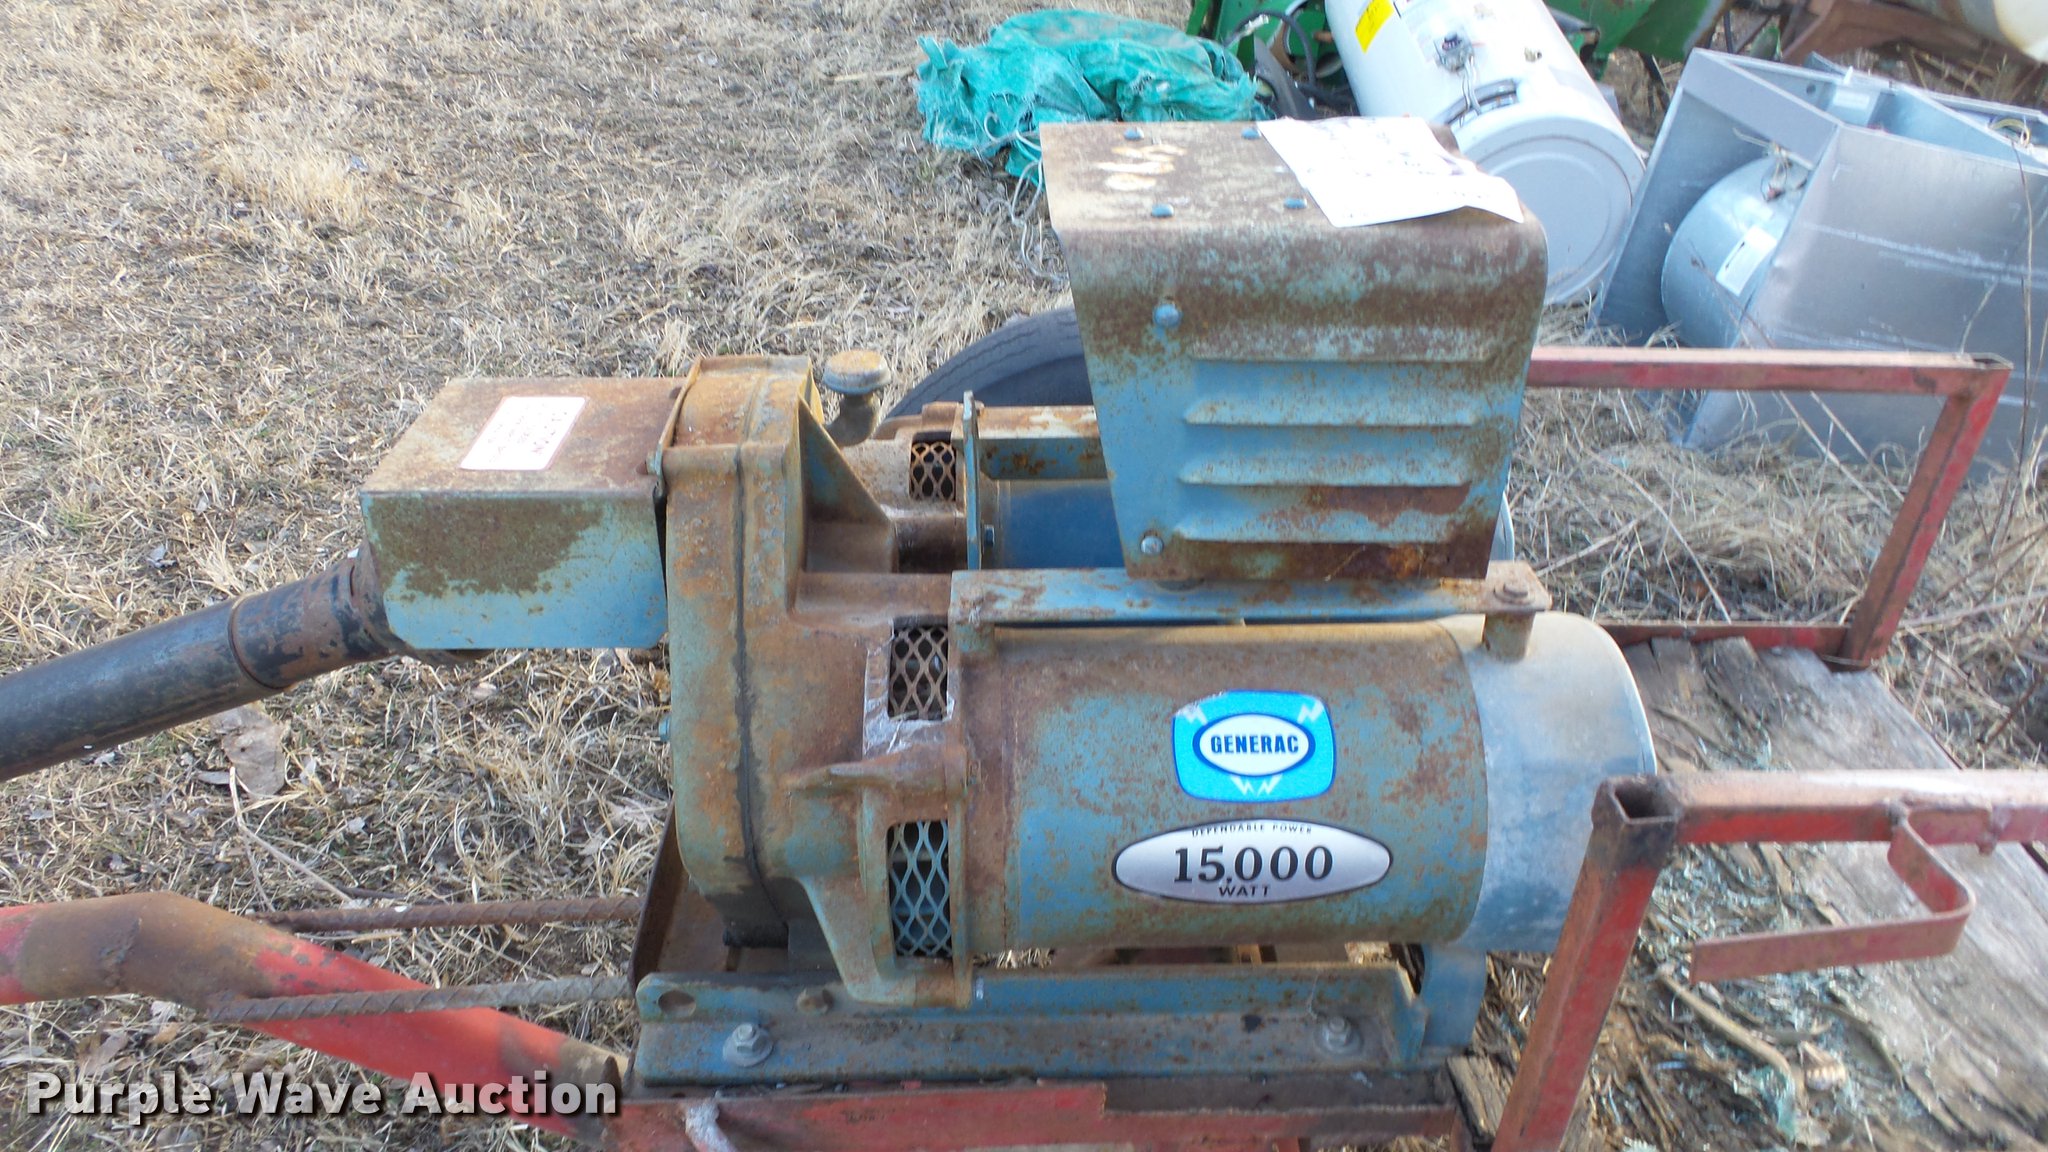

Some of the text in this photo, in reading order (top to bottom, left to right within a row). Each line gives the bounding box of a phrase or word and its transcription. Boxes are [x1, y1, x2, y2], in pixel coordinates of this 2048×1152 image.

[1210, 734, 1300, 754] GENERAC
[1191, 823, 1312, 837] DEPENDABLE POWER
[1173, 844, 1334, 884] 15,000
[1218, 884, 1271, 897] WATT
